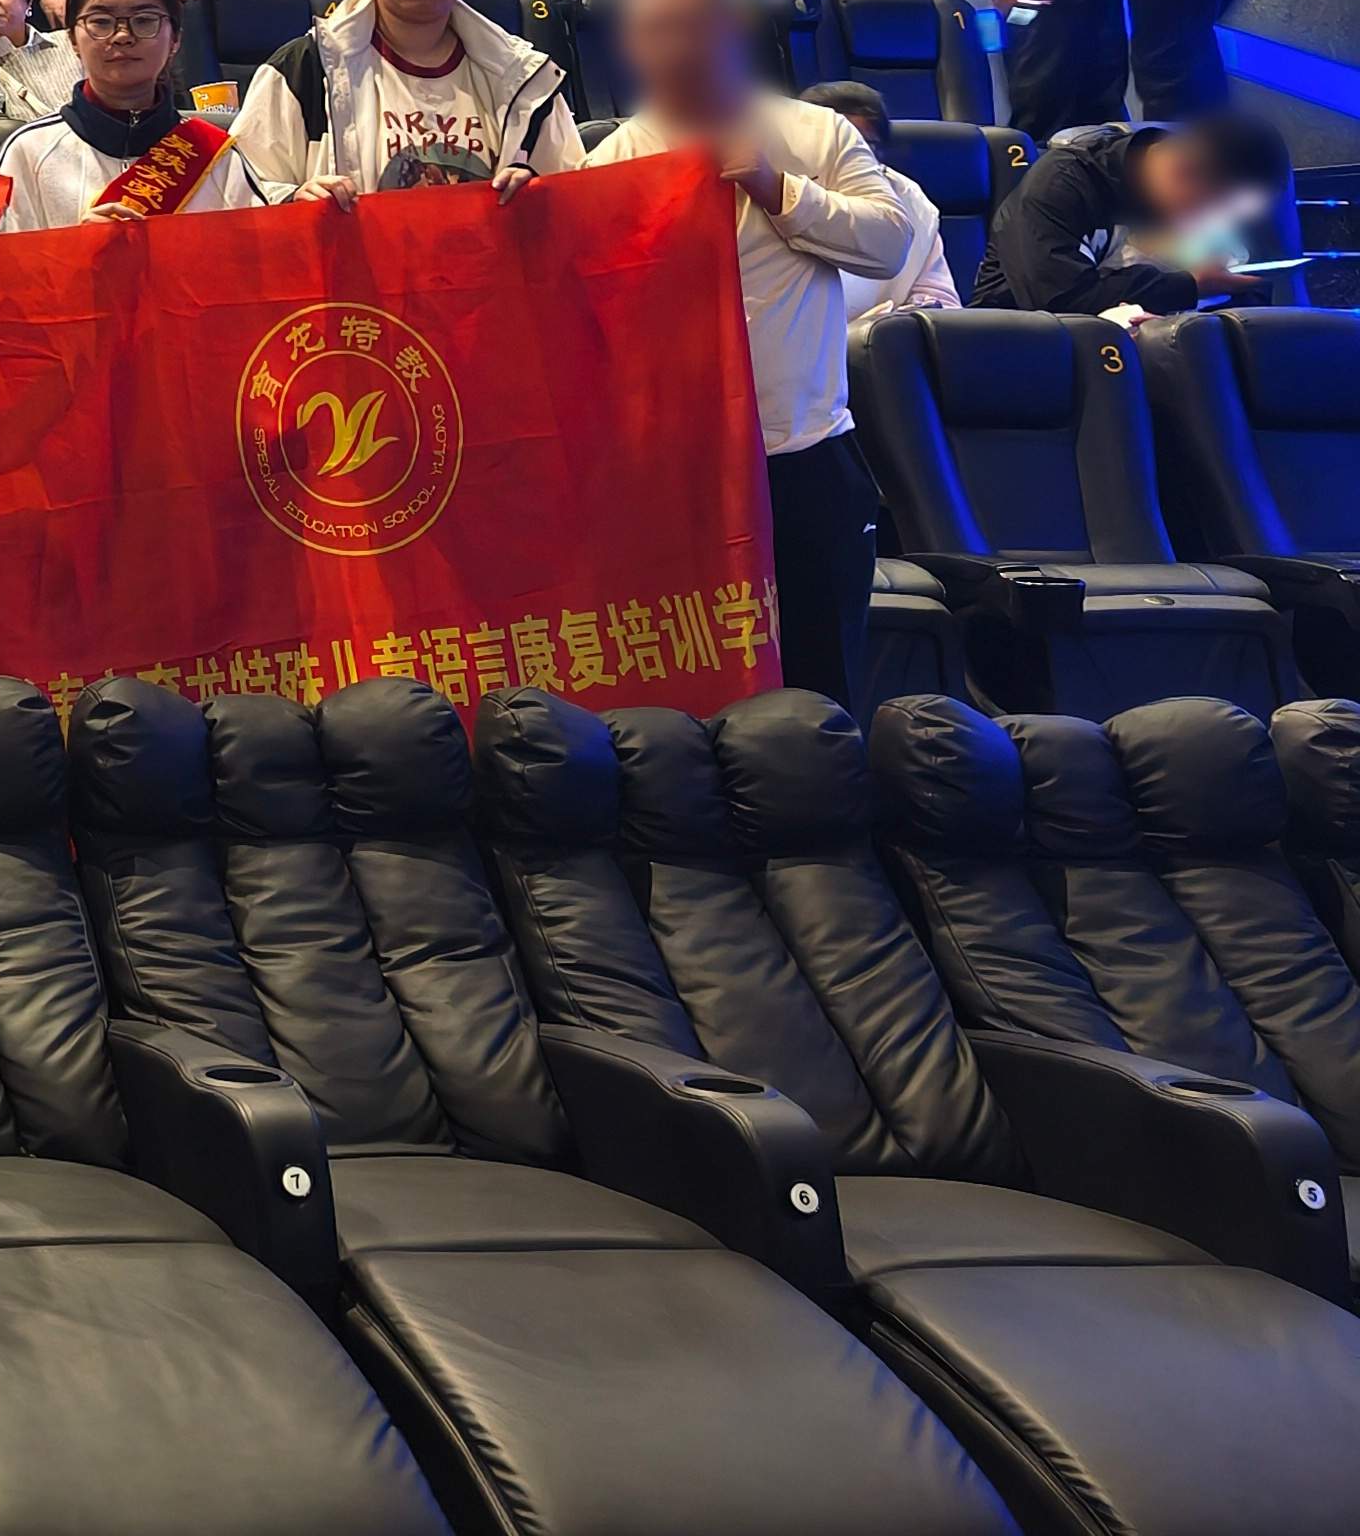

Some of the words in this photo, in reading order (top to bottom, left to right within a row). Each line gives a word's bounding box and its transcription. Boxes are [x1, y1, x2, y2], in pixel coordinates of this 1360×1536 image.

[532, 0, 550, 18] 3
[953, 11, 966, 30] 1
[1007, 144, 1029, 167] 2
[1100, 345, 1124, 374] 3
[254, 427, 281, 502] SPECIAL
[282, 500, 378, 537] EDUCATION
[382, 485, 436, 528] SCHOOL
[291, 1172, 301, 1191] 7
[799, 1189, 810, 1208] 6
[1308, 1186, 1318, 1206] 5
